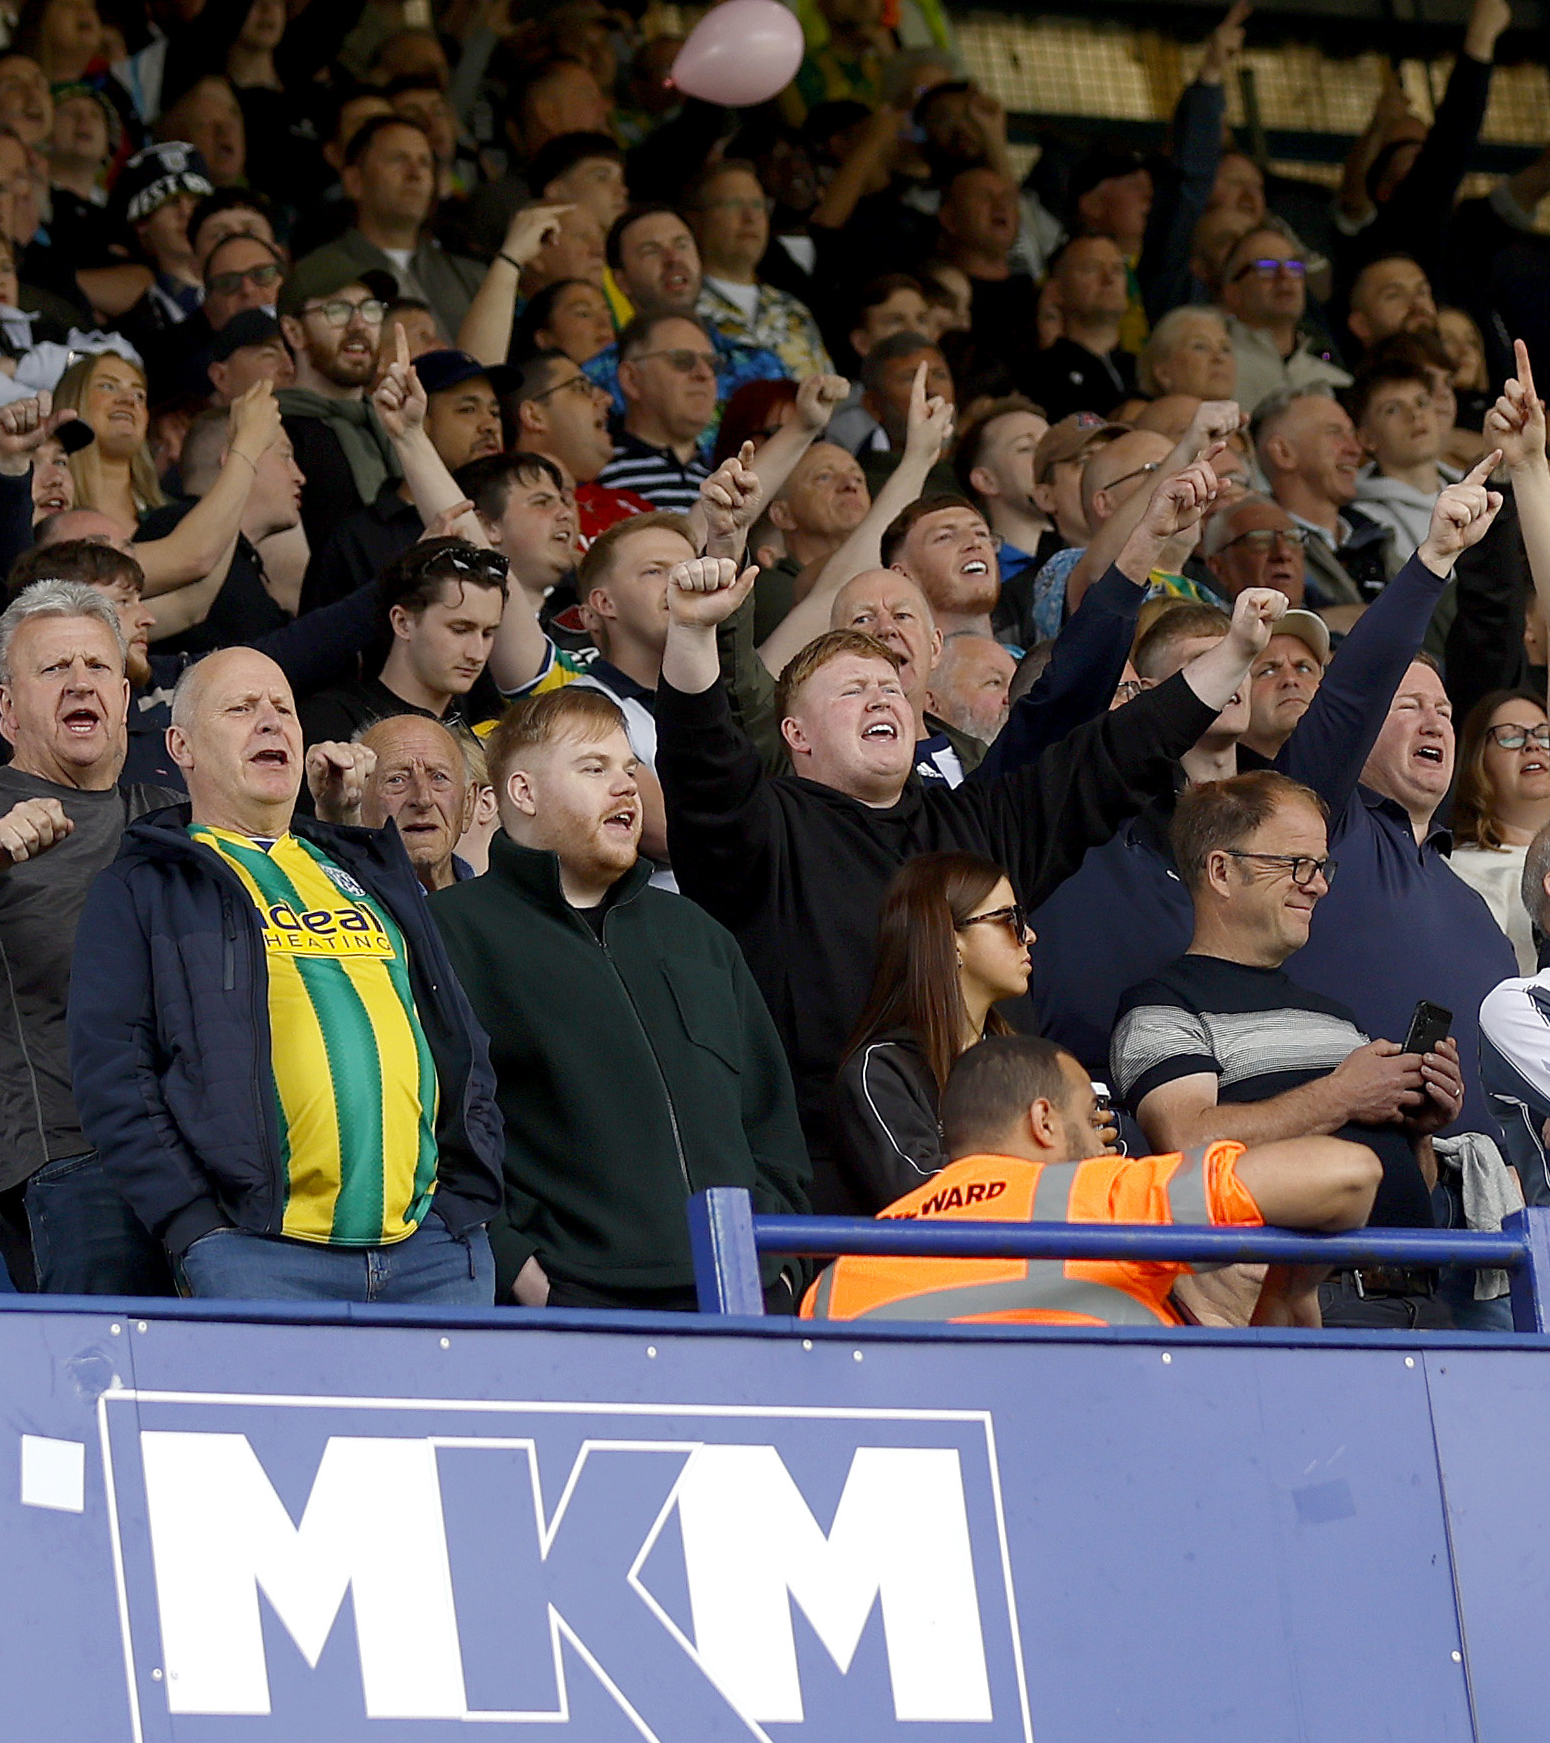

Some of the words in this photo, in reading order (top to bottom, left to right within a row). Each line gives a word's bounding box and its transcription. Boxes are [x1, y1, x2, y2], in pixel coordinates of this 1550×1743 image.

[264, 933, 391, 951] HEATING
[876, 1181, 1007, 1219] WARD
[139, 1431, 994, 1743] MKM
